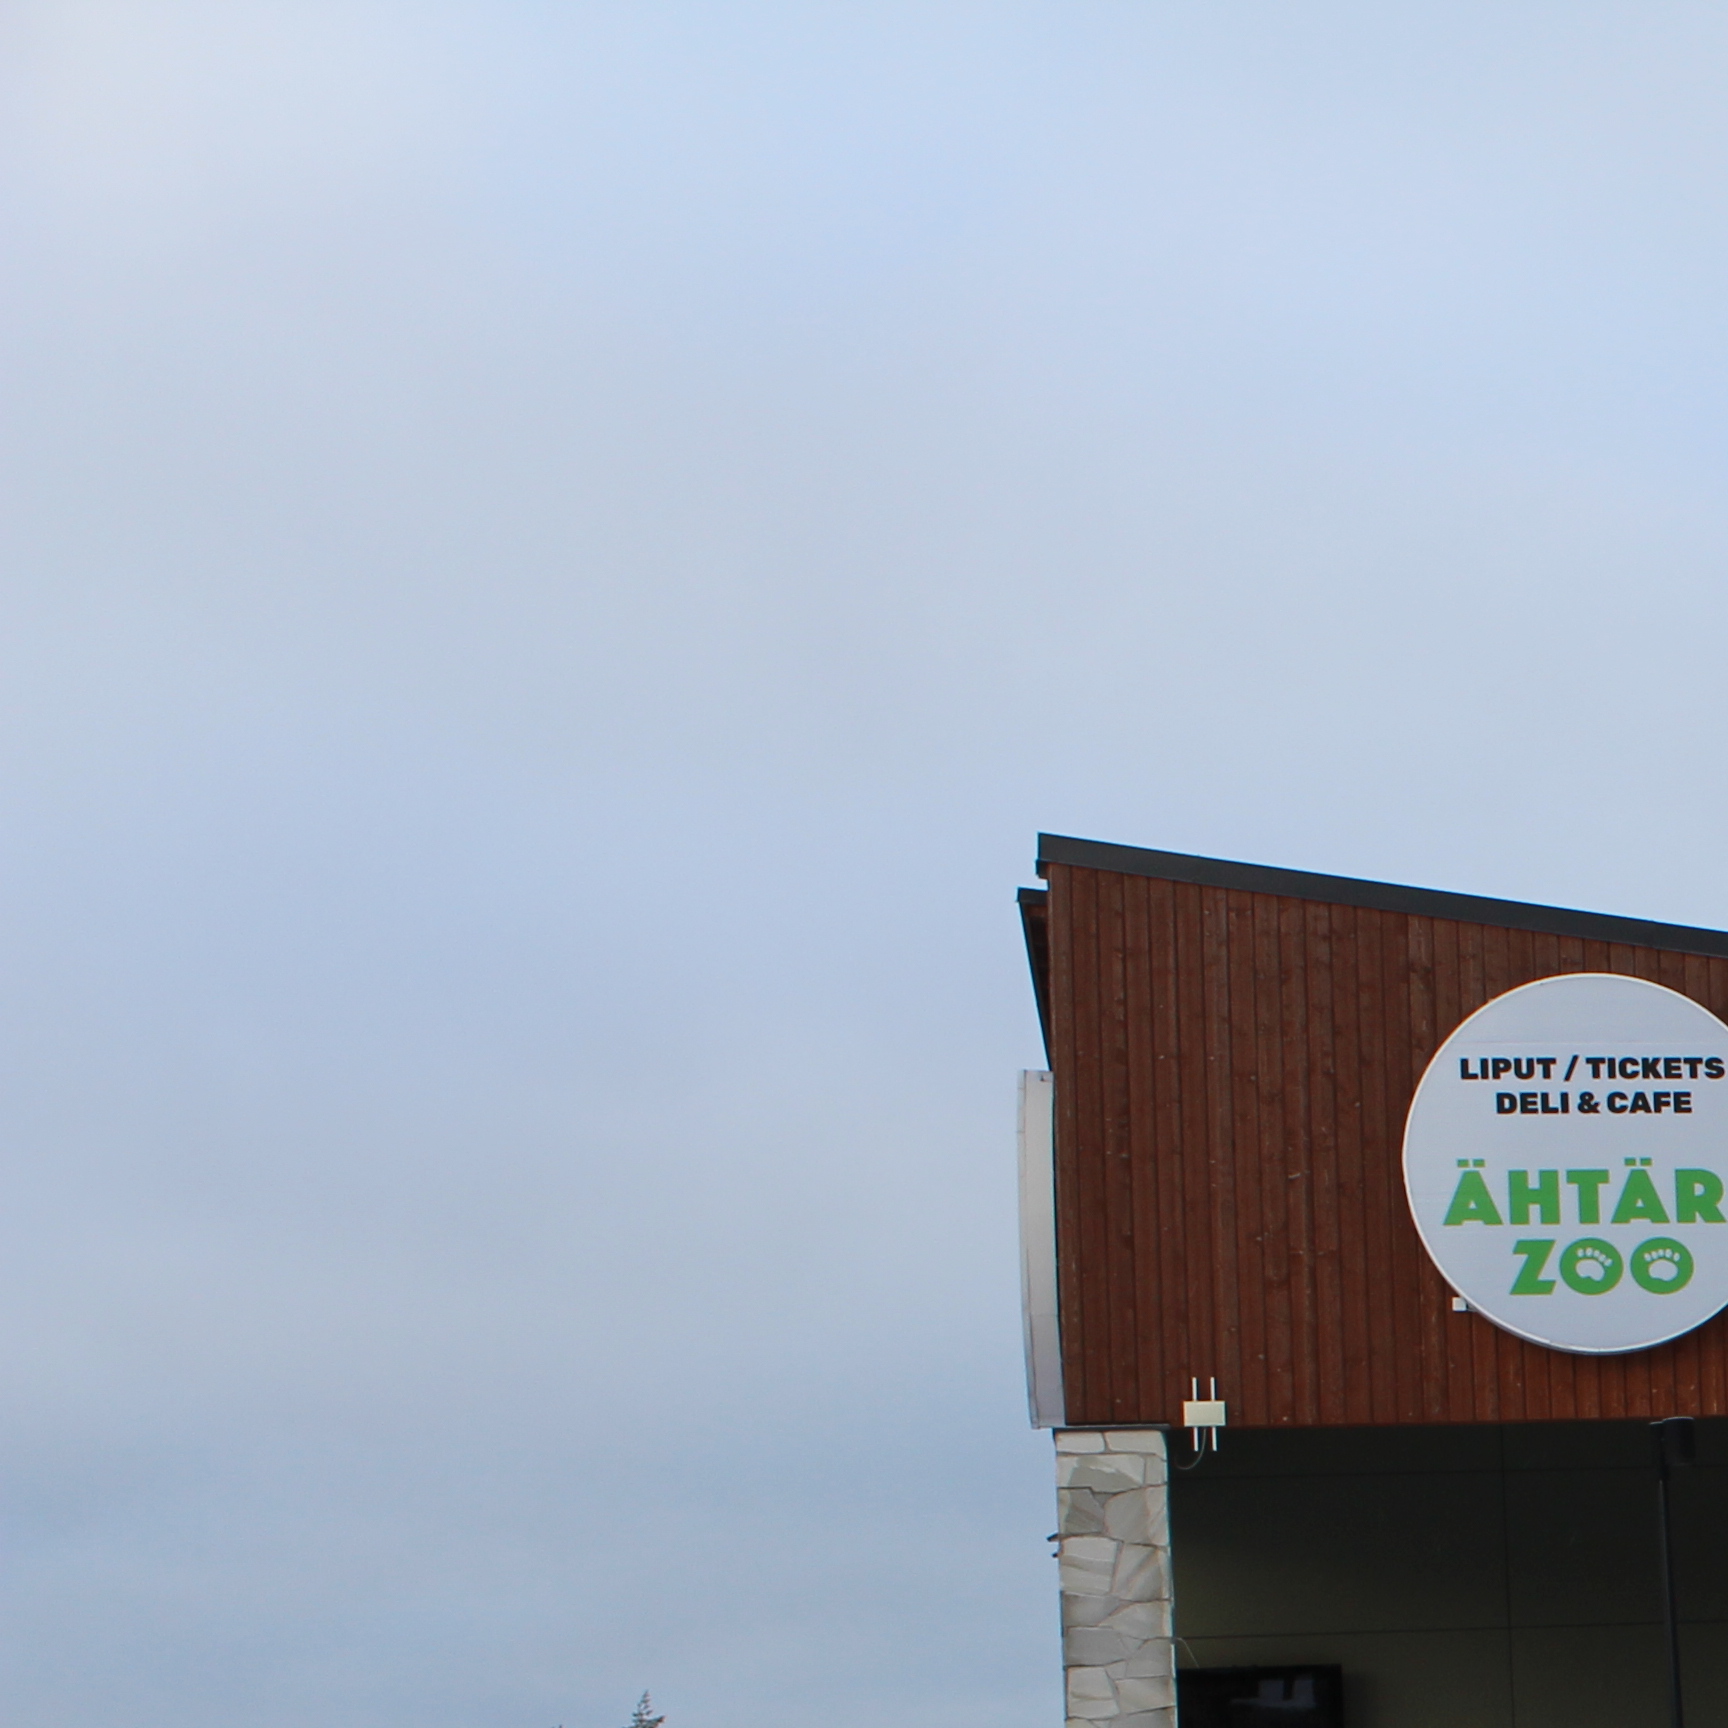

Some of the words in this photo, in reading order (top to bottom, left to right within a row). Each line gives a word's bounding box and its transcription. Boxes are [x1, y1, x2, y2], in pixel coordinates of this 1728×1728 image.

[1460, 1057, 1557, 1080] LIPUT
[1586, 1057, 1726, 1080] TICKETS
[1496, 1092, 1570, 1115] DELI
[1577, 1092, 1600, 1114] &
[1606, 1091, 1693, 1114] CAFE
[1510, 1237, 1695, 1296] ZOO
